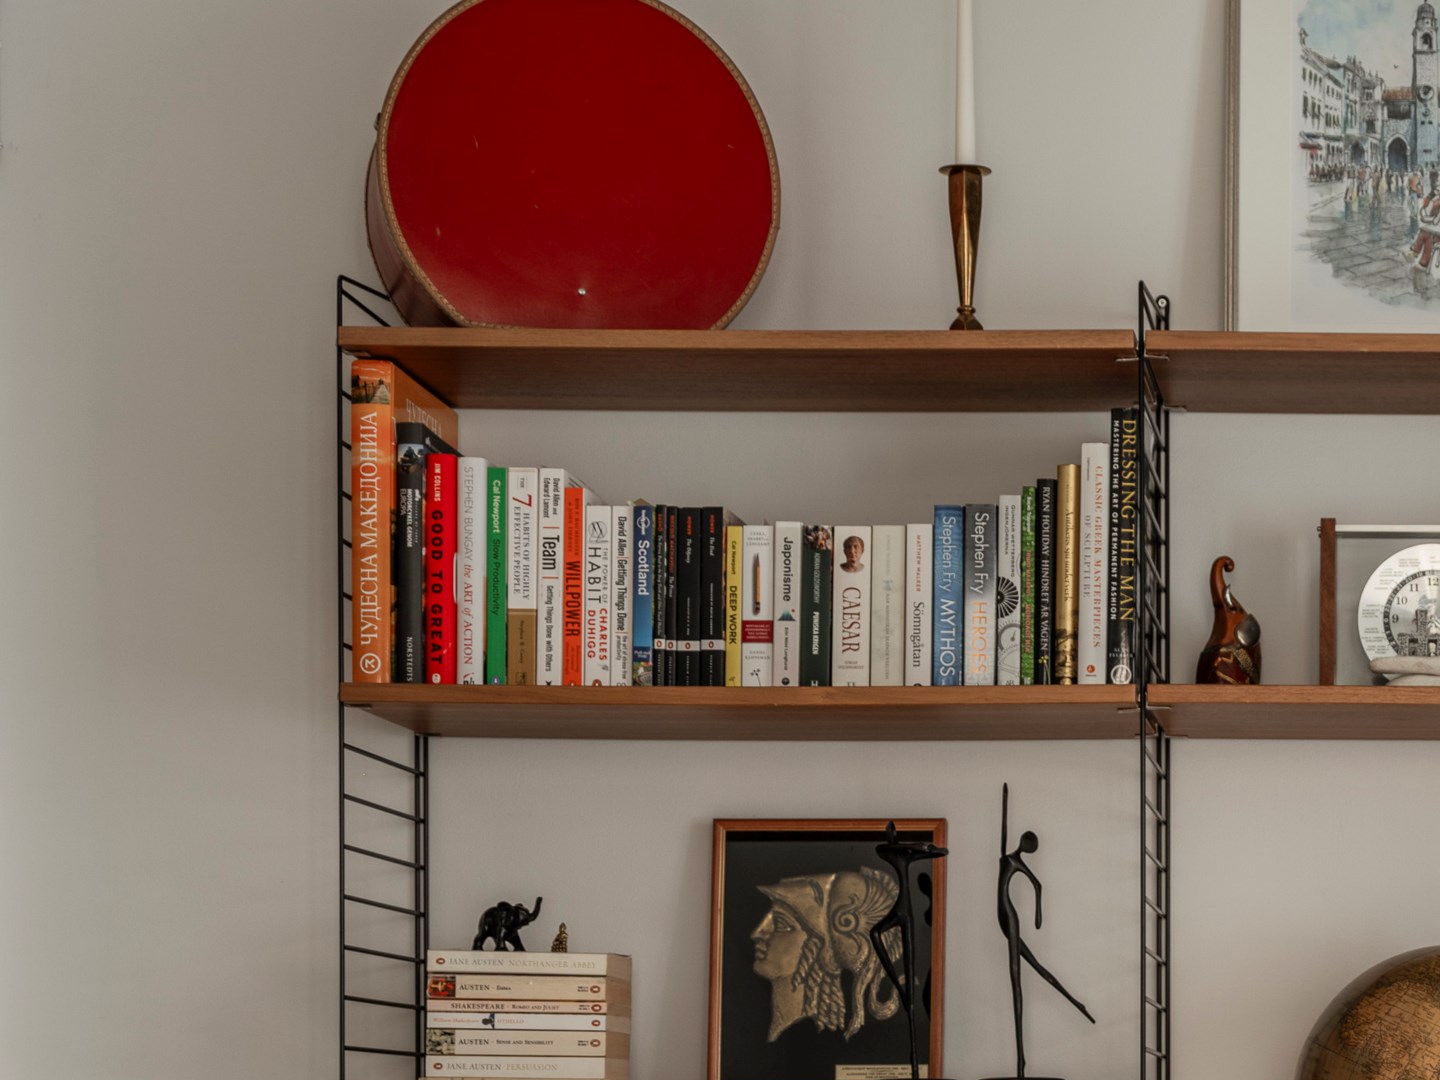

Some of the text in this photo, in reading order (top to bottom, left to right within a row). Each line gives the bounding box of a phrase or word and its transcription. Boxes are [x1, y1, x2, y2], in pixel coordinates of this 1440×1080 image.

[360, 412, 380, 645] ЧУДЕСНА МАКЕДОНИЈА
[492, 496, 500, 533] Newport
[513, 506, 521, 557] EFFECTIVE
[618, 517, 627, 537] David
[1041, 487, 1050, 601] RYAN HOLIDAY HINDRET
[1120, 420, 1136, 620] DRESSING THE MAN
[463, 467, 473, 664] STEPHEN BUNGAY ART ACTION
[512, 494, 532, 600] 7 HABITS HIGHLY
[542, 535, 560, 570] Team
[588, 547, 601, 604] HABIT
[638, 540, 649, 595] Scotland
[781, 537, 793, 602] Japonisme
[431, 510, 443, 664] GOOD TO GREAT
[566, 561, 581, 637] WILLPOWER
[939, 516, 956, 676] Stephen Fry MYTHOS
[970, 512, 989, 673] Stephen Fry HEROES
[1093, 559, 1102, 648] MASTERPIECES
[1396, 597, 1407, 605] 10
[1410, 584, 1419, 592] 11
[1428, 578, 1439, 586] 12
[587, 610, 596, 659] DUHIGG
[599, 608, 607, 661] CHARLES
[841, 587, 861, 653] CAESAR
[910, 602, 924, 667] Sömngåtan
[1392, 615, 1399, 623] 9
[509, 959, 569, 968] NORTHANGER
